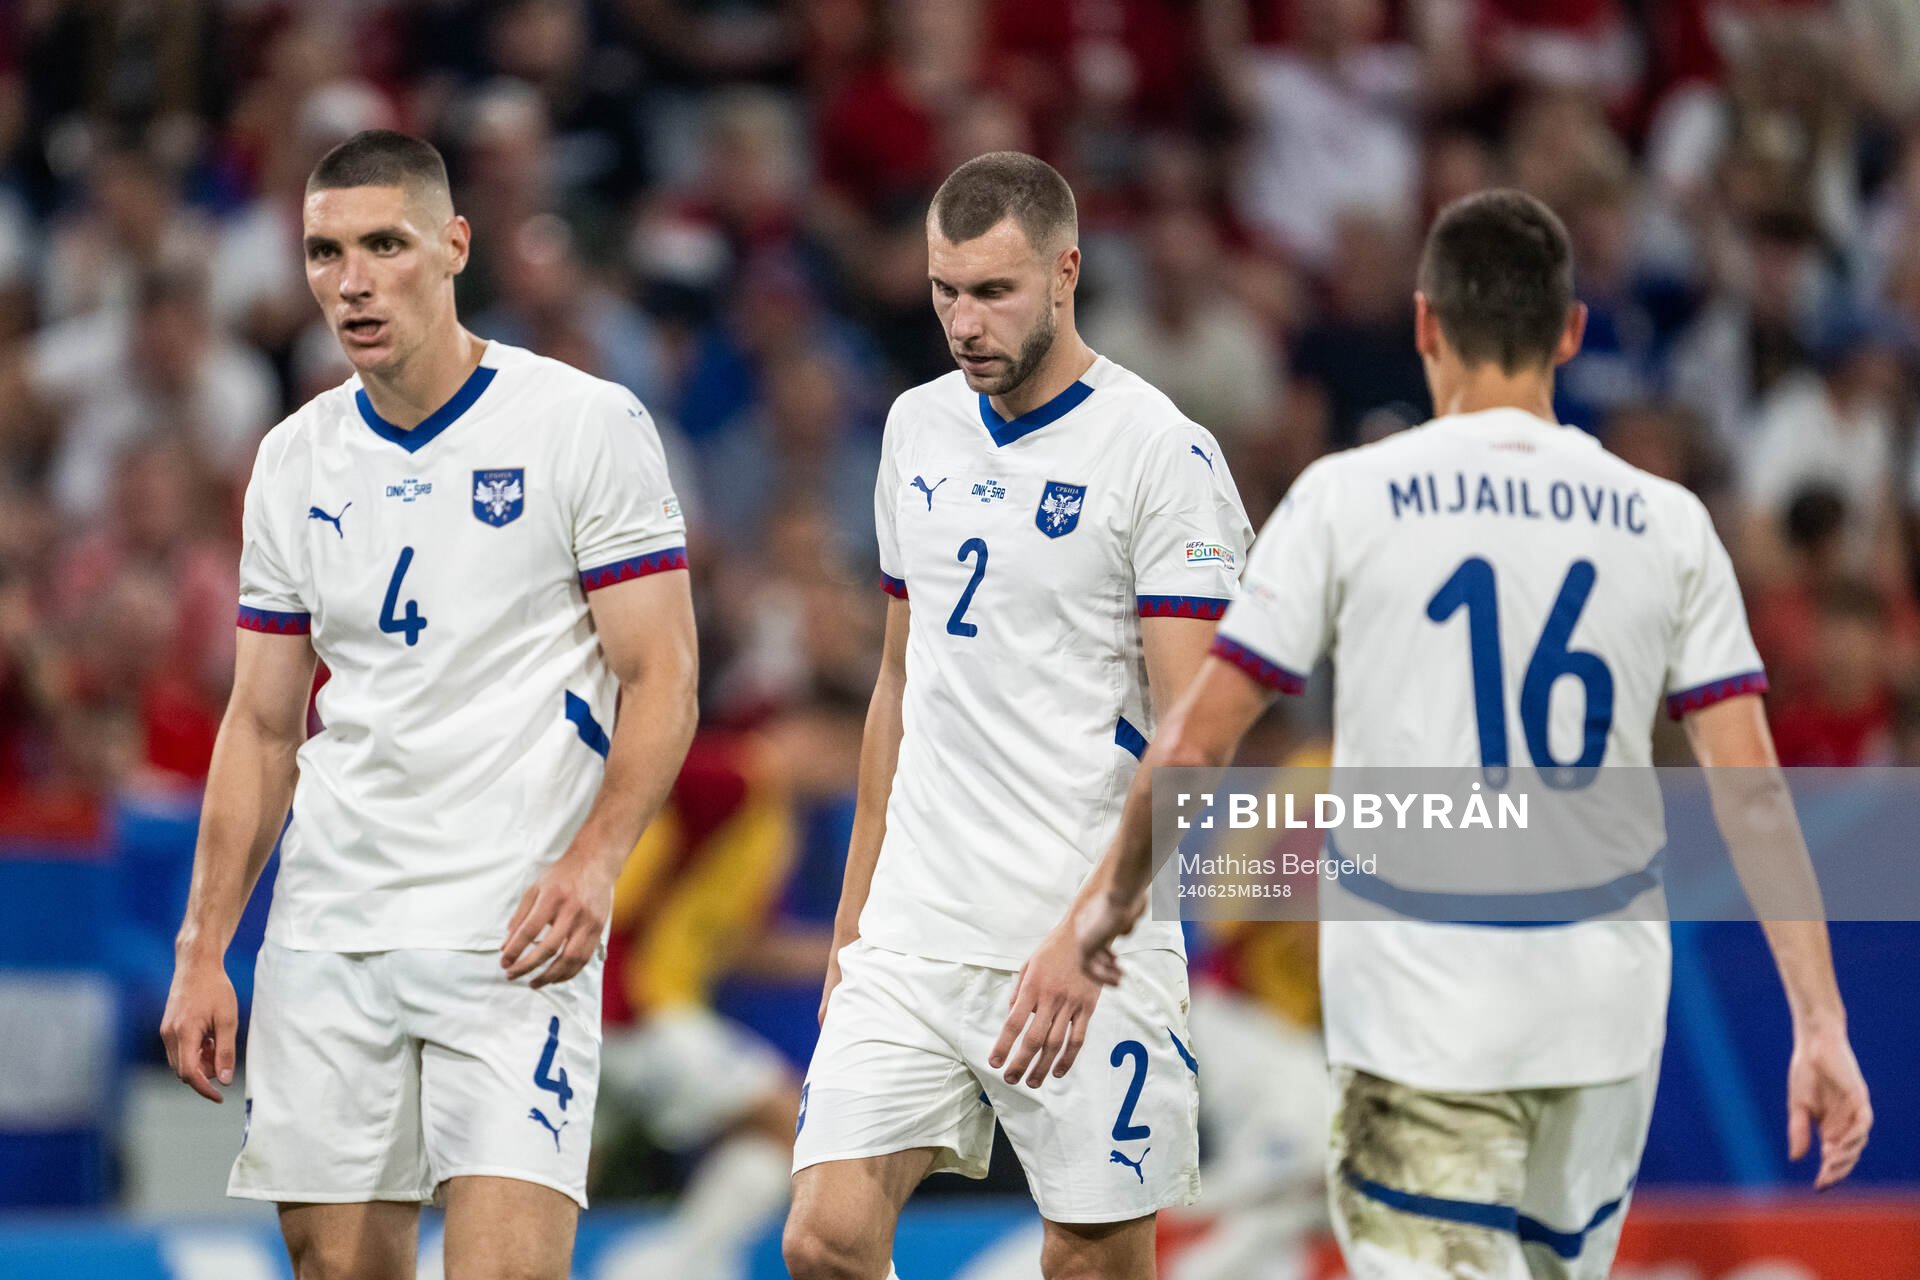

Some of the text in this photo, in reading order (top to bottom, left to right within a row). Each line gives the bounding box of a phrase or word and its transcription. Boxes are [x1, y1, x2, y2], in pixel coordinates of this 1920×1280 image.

[1388, 471, 1647, 535] MIJAILOVIĆ
[378, 546, 428, 647] 4
[946, 537, 988, 638] 2
[1186, 547, 1235, 564] FOUNTION
[1425, 555, 1615, 789] 16
[533, 1015, 574, 1111] 4
[1110, 1039, 1151, 1142] 2
